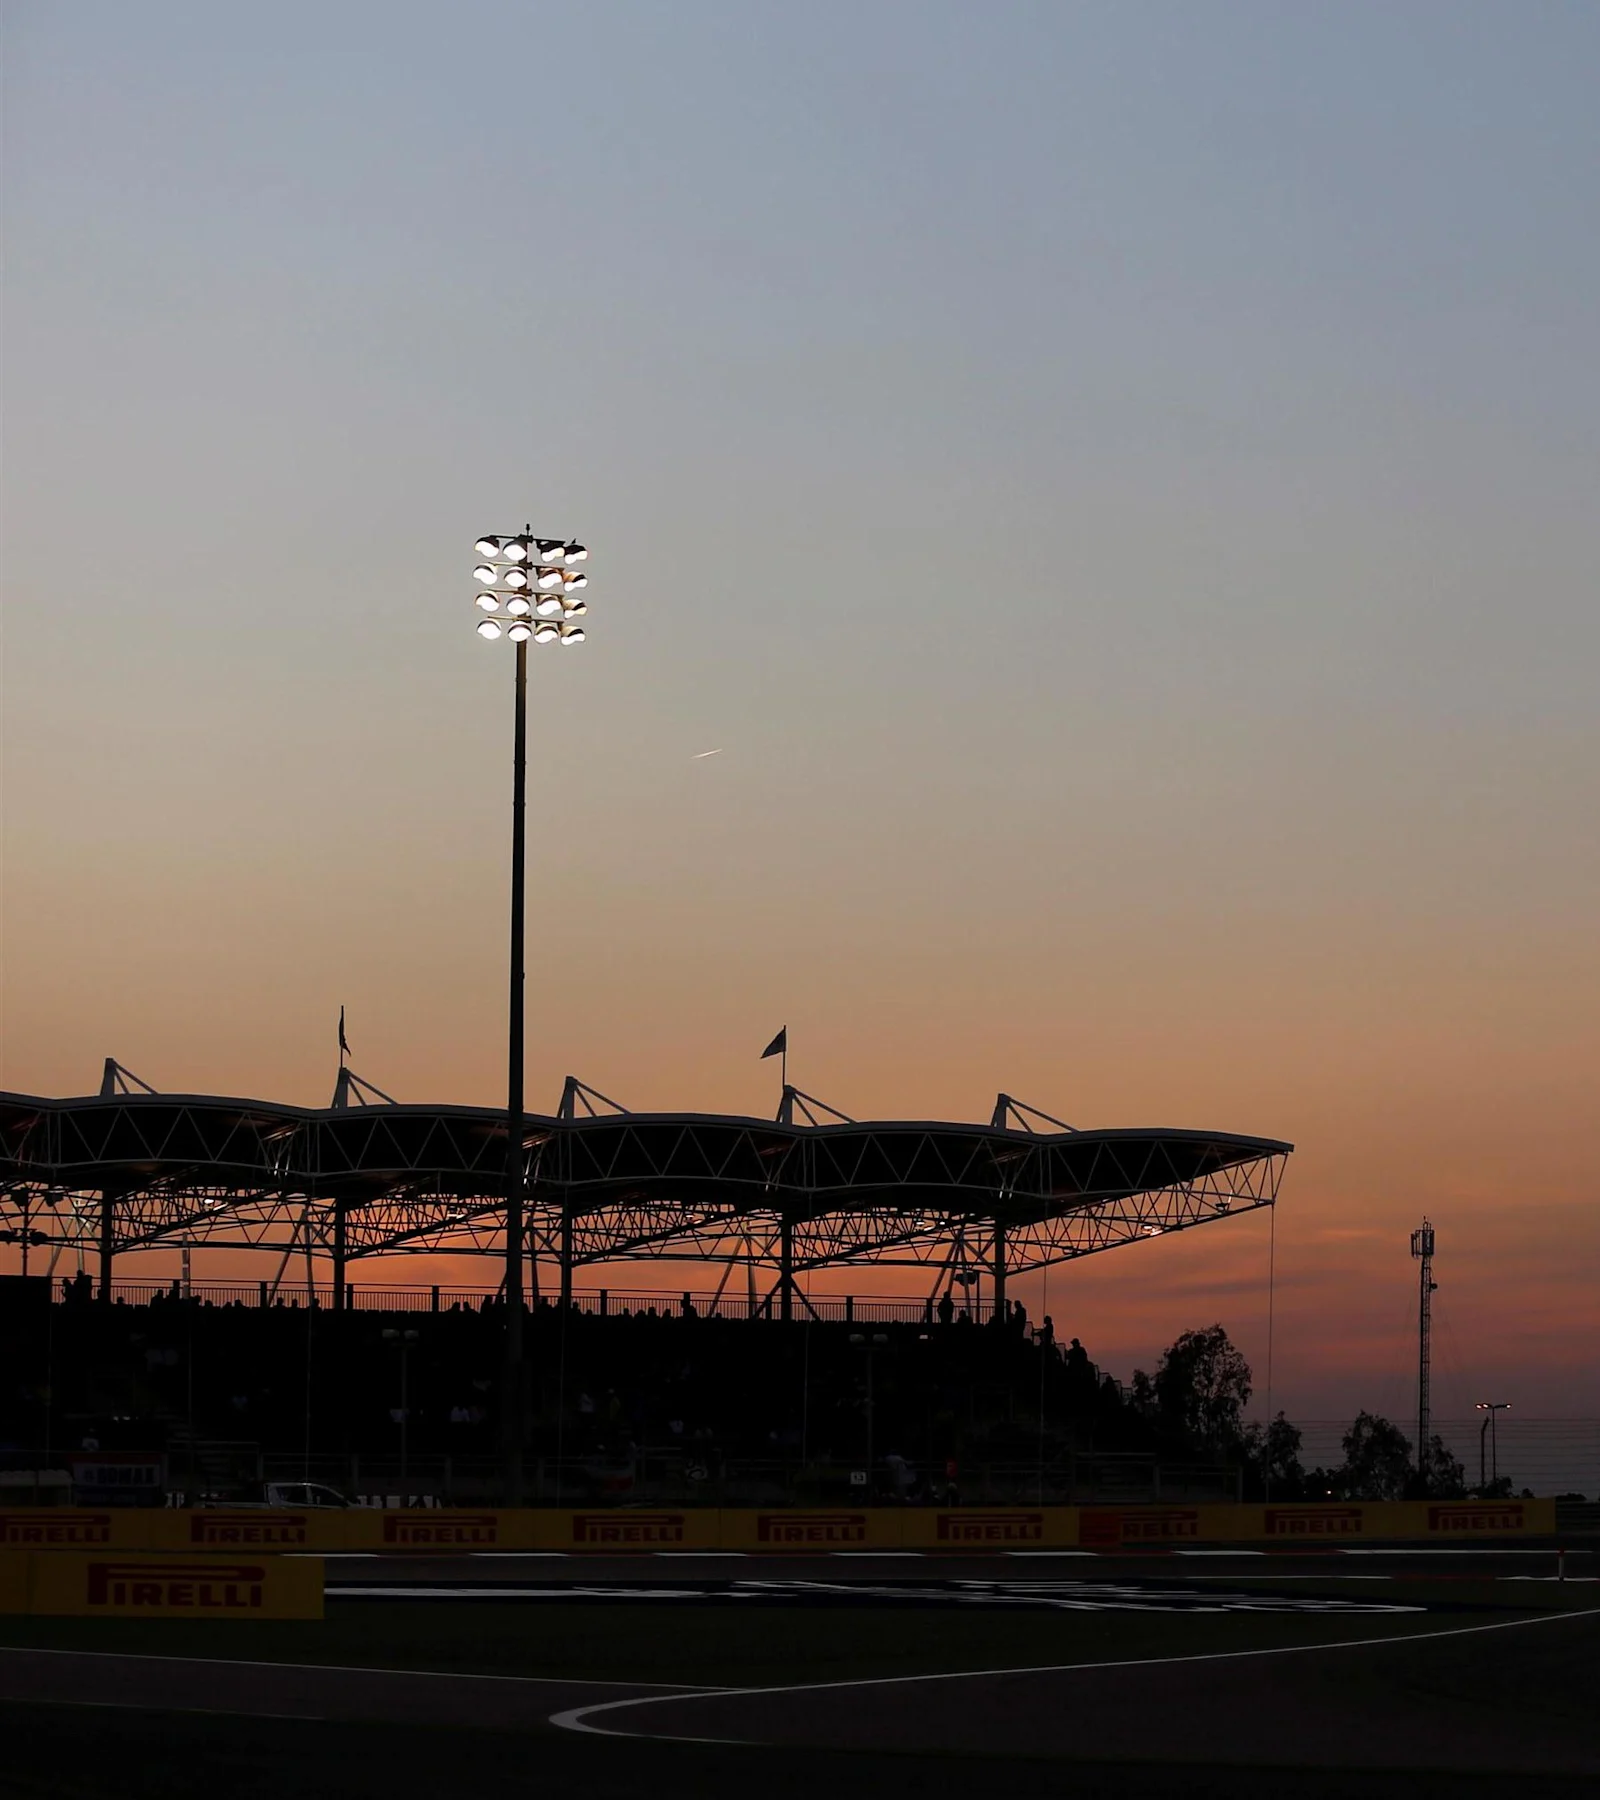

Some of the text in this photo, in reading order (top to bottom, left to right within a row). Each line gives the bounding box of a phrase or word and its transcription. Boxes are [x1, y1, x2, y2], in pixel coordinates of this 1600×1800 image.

[191, 1515, 308, 1543] PIRELLI
[384, 1516, 498, 1543] PIRELLI
[573, 1515, 687, 1543] PIRELLI
[758, 1515, 867, 1542] PIRELLI
[937, 1514, 1045, 1541] PIRELLI
[1265, 1509, 1363, 1535] PIRELLI
[1428, 1505, 1525, 1532] PIRELLI
[87, 1563, 267, 1608] PIRELLI
